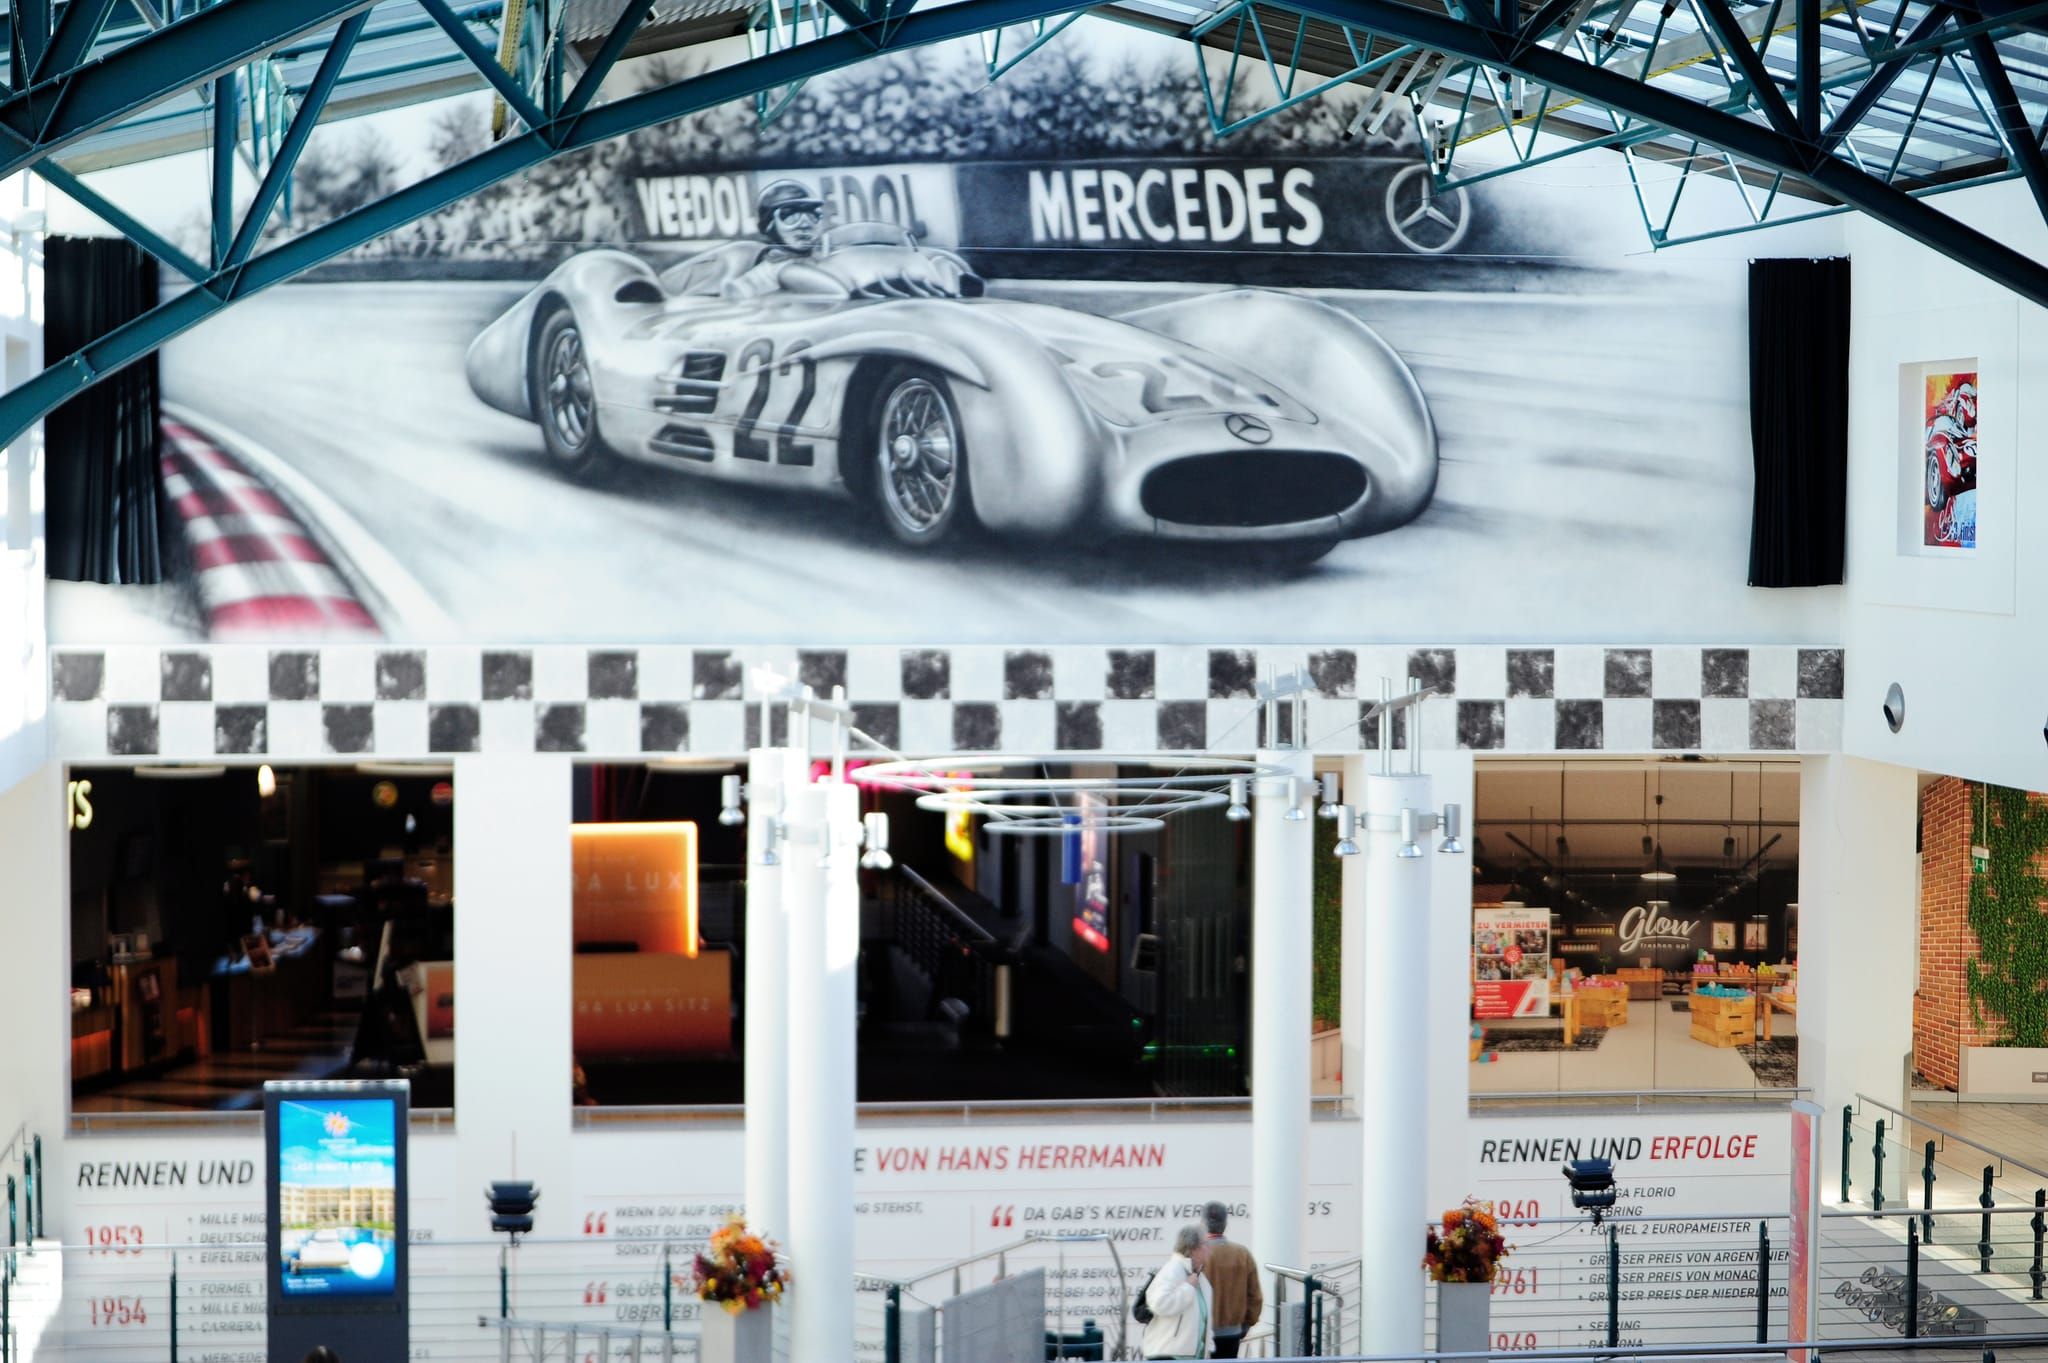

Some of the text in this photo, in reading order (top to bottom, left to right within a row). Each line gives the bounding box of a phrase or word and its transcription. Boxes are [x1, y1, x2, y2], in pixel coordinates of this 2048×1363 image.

[635, 174, 758, 238] VEEDOL
[1029, 167, 1323, 245] MERCEDES
[733, 337, 818, 467] 22
[625, 871, 683, 891] LUX
[1495, 921, 1548, 929] VERMIETEN
[1619, 904, 1700, 953] Glow
[1480, 1134, 1758, 1163] RENNEN UND ERFOLGE
[876, 1146, 929, 1172] VON
[937, 1145, 1009, 1171] HANS
[1018, 1143, 1166, 1170] HERRMANN
[78, 1159, 254, 1187] RENNEN UND
[1633, 1186, 1676, 1198] FLORIO
[616, 1205, 653, 1217] WENN
[658, 1205, 675, 1217] DU
[680, 1204, 705, 1216] AUF
[873, 1202, 923, 1213] STEHST,
[1024, 1207, 1045, 1220] DA
[1051, 1205, 1100, 1220] GAB'S
[1105, 1205, 1167, 1219] KEINEN
[1172, 1203, 1249, 1219] VERAG,
[200, 1213, 266, 1224] MILLE MIG
[616, 1223, 711, 1236] MUSST DU DEN
[1642, 1223, 1649, 1234] 2
[1652, 1221, 1751, 1234] EUROPAMEISTER
[84, 1225, 144, 1255] 1953
[616, 1243, 658, 1256] SONST
[200, 1251, 266, 1263] EIFELREN
[1648, 1253, 1682, 1264] PREIS
[1687, 1252, 1711, 1263] VON
[1648, 1271, 1682, 1282] PREIS
[1687, 1271, 1711, 1281] VON
[200, 1282, 251, 1294] FORMEL
[1648, 1289, 1682, 1300] PREIS
[1685, 1289, 1708, 1299] DER
[89, 1296, 147, 1326] 1954
[201, 1301, 266, 1313] MILLE MIG
[201, 1321, 262, 1332] CARRERA
